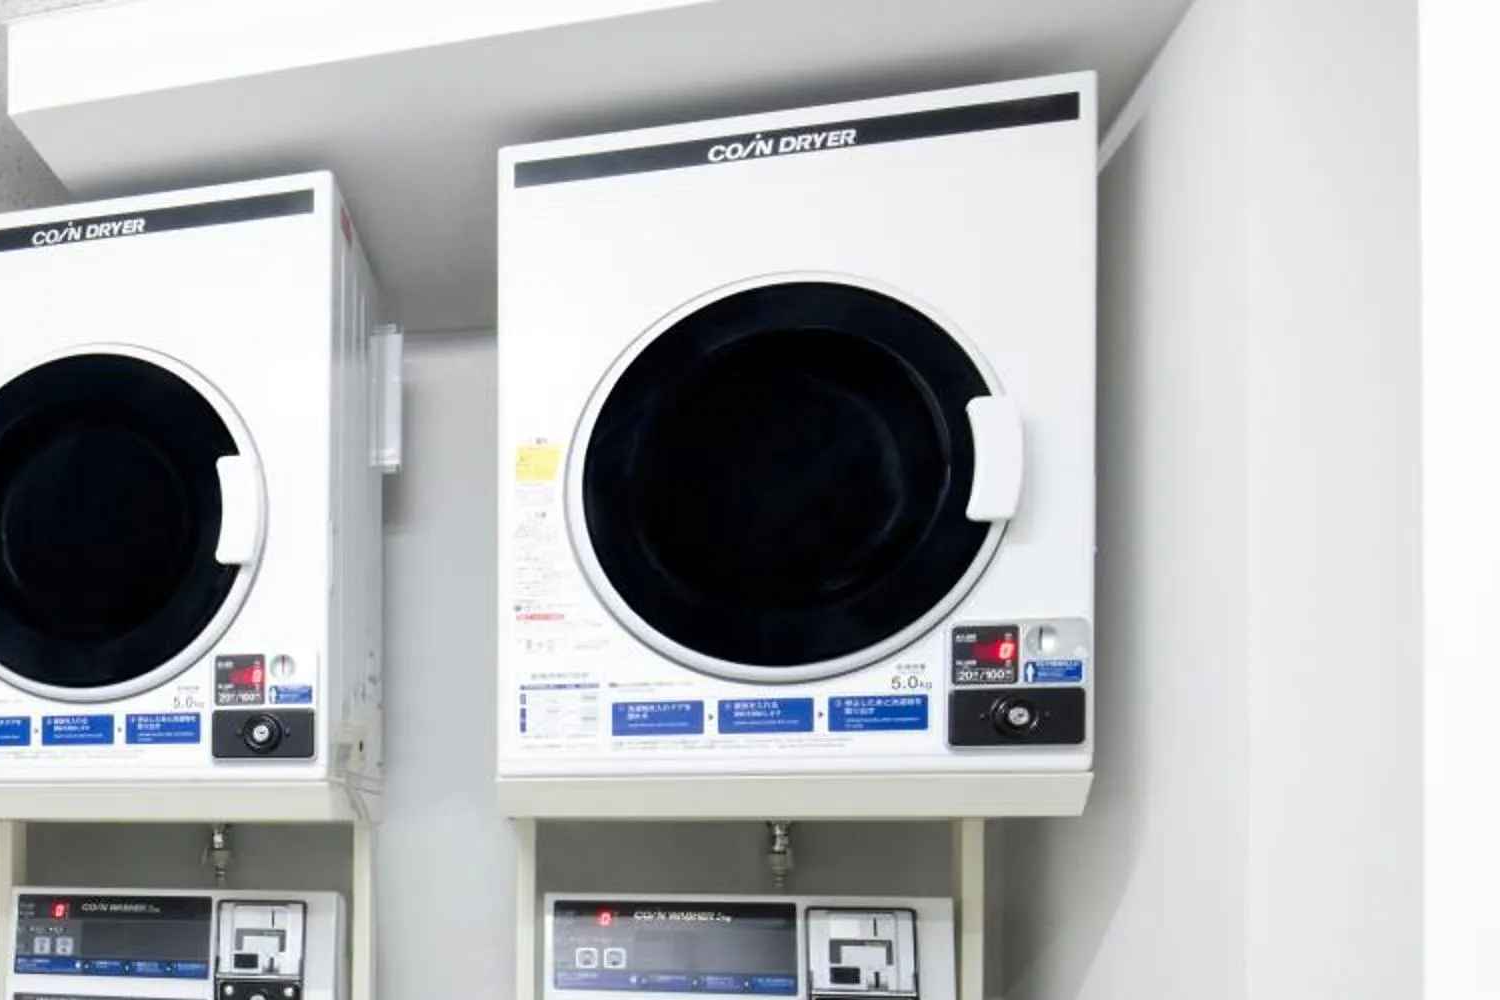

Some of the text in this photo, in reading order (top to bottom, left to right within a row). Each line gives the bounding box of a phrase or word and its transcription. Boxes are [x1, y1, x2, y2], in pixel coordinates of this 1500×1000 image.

[778, 128, 857, 153] DRYER
[85, 218, 146, 239] DRYER
[999, 643, 1015, 659] 0
[54, 904, 65, 917] 0
[599, 912, 612, 926] 0
